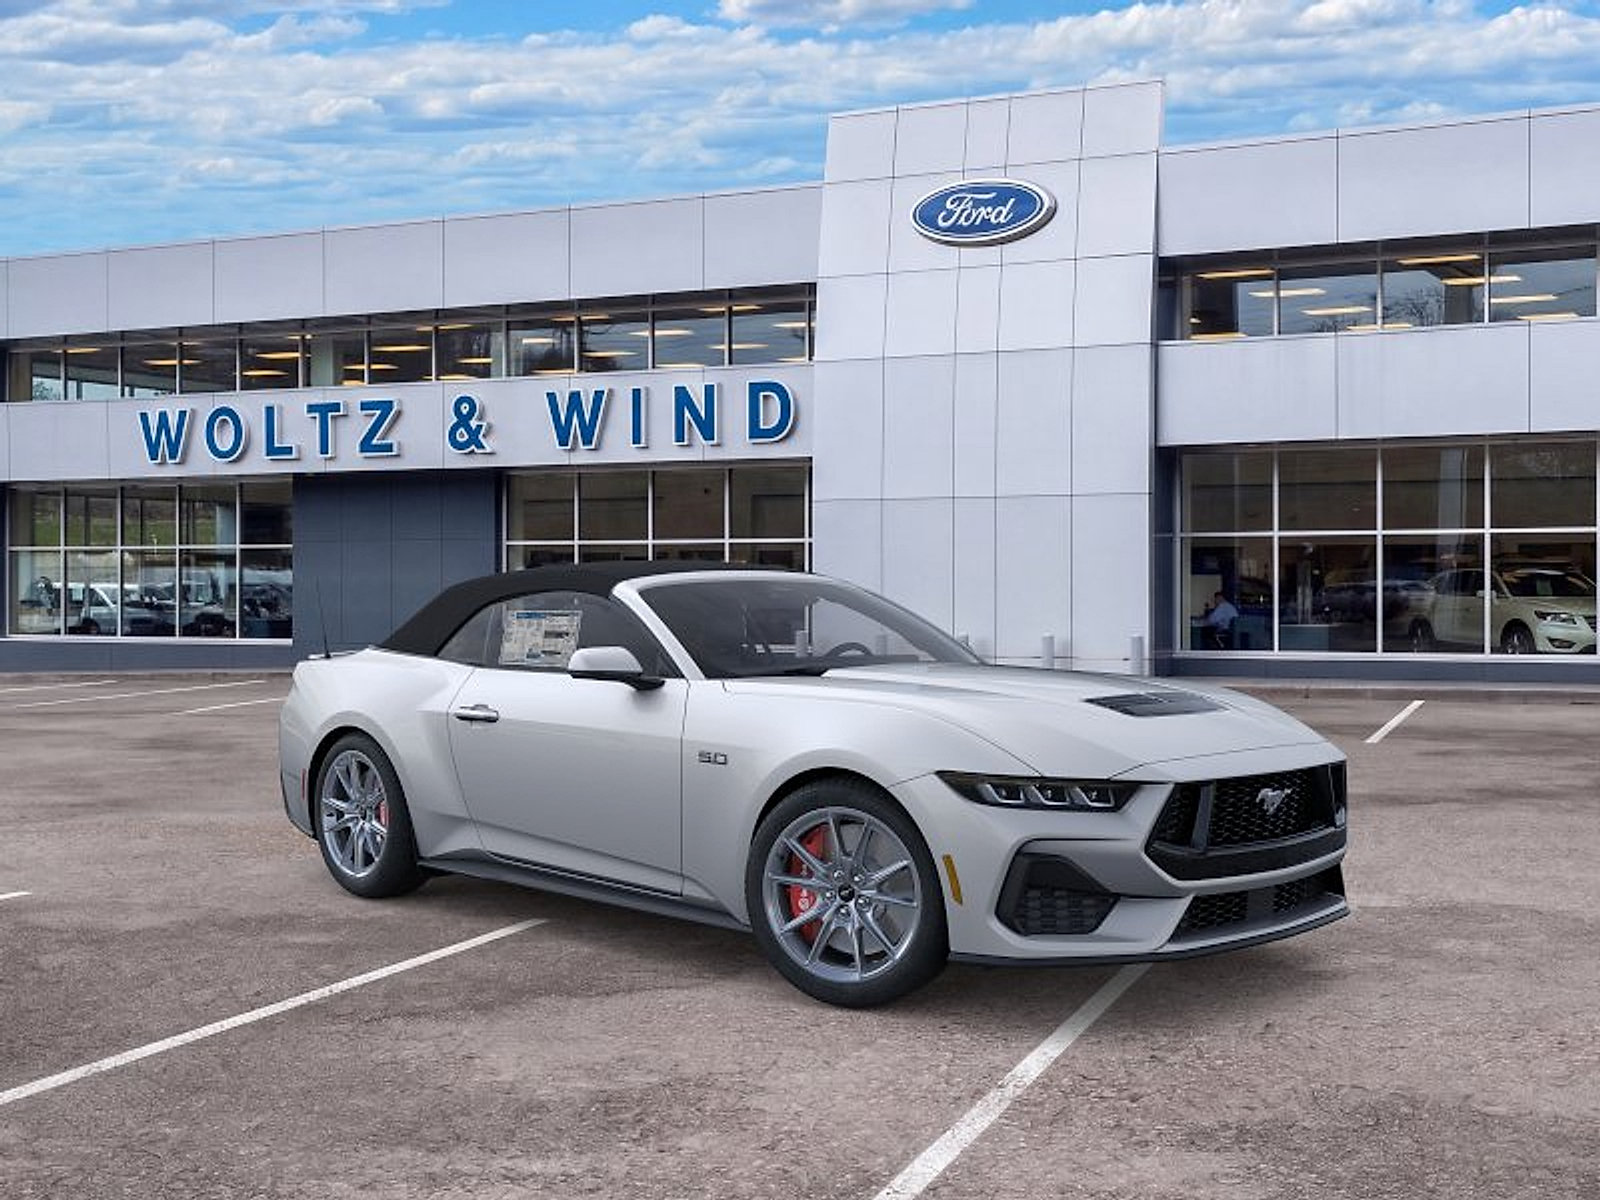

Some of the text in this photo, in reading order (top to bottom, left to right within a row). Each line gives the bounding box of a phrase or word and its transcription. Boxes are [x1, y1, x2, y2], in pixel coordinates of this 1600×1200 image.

[937, 191, 1016, 228] Ford
[138, 379, 797, 465] WOLTZ & WIND
